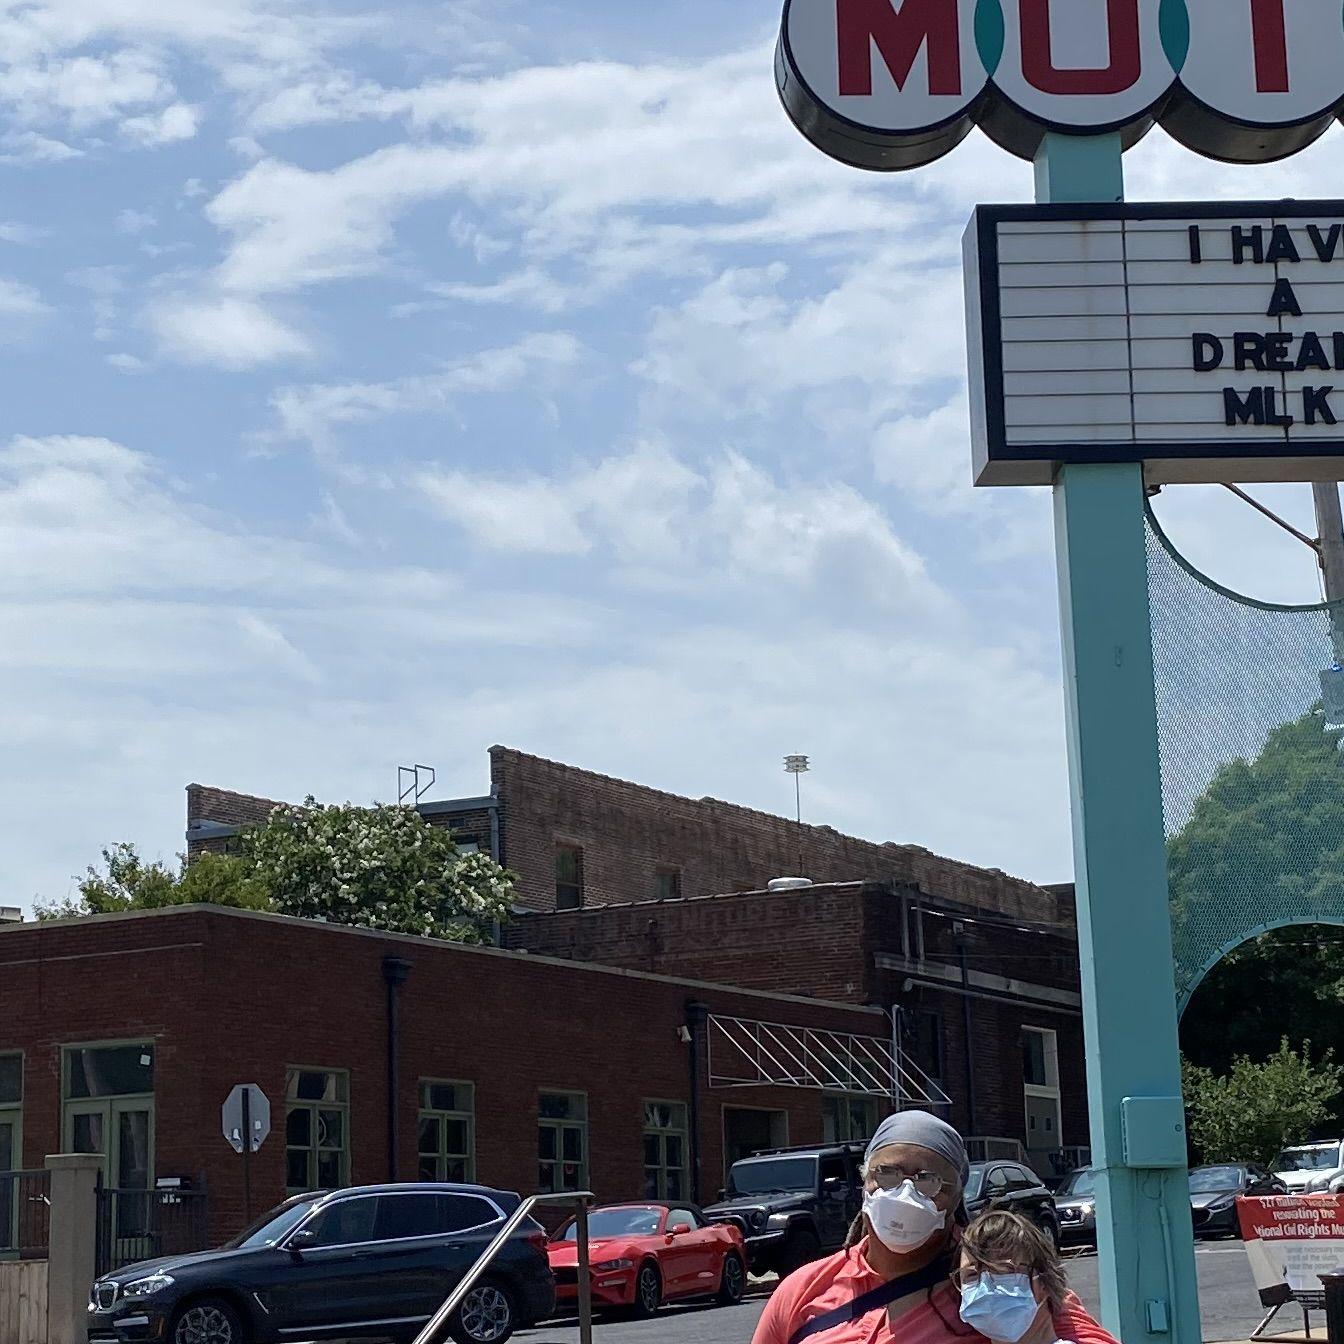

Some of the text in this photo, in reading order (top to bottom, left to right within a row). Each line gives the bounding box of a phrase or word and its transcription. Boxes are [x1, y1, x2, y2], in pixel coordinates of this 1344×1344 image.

[1188, 224, 1201, 264] I
[1266, 277, 1303, 316] A
[1320, 1208, 1336, 1218] the
[1297, 1223, 1330, 1238] Rights
